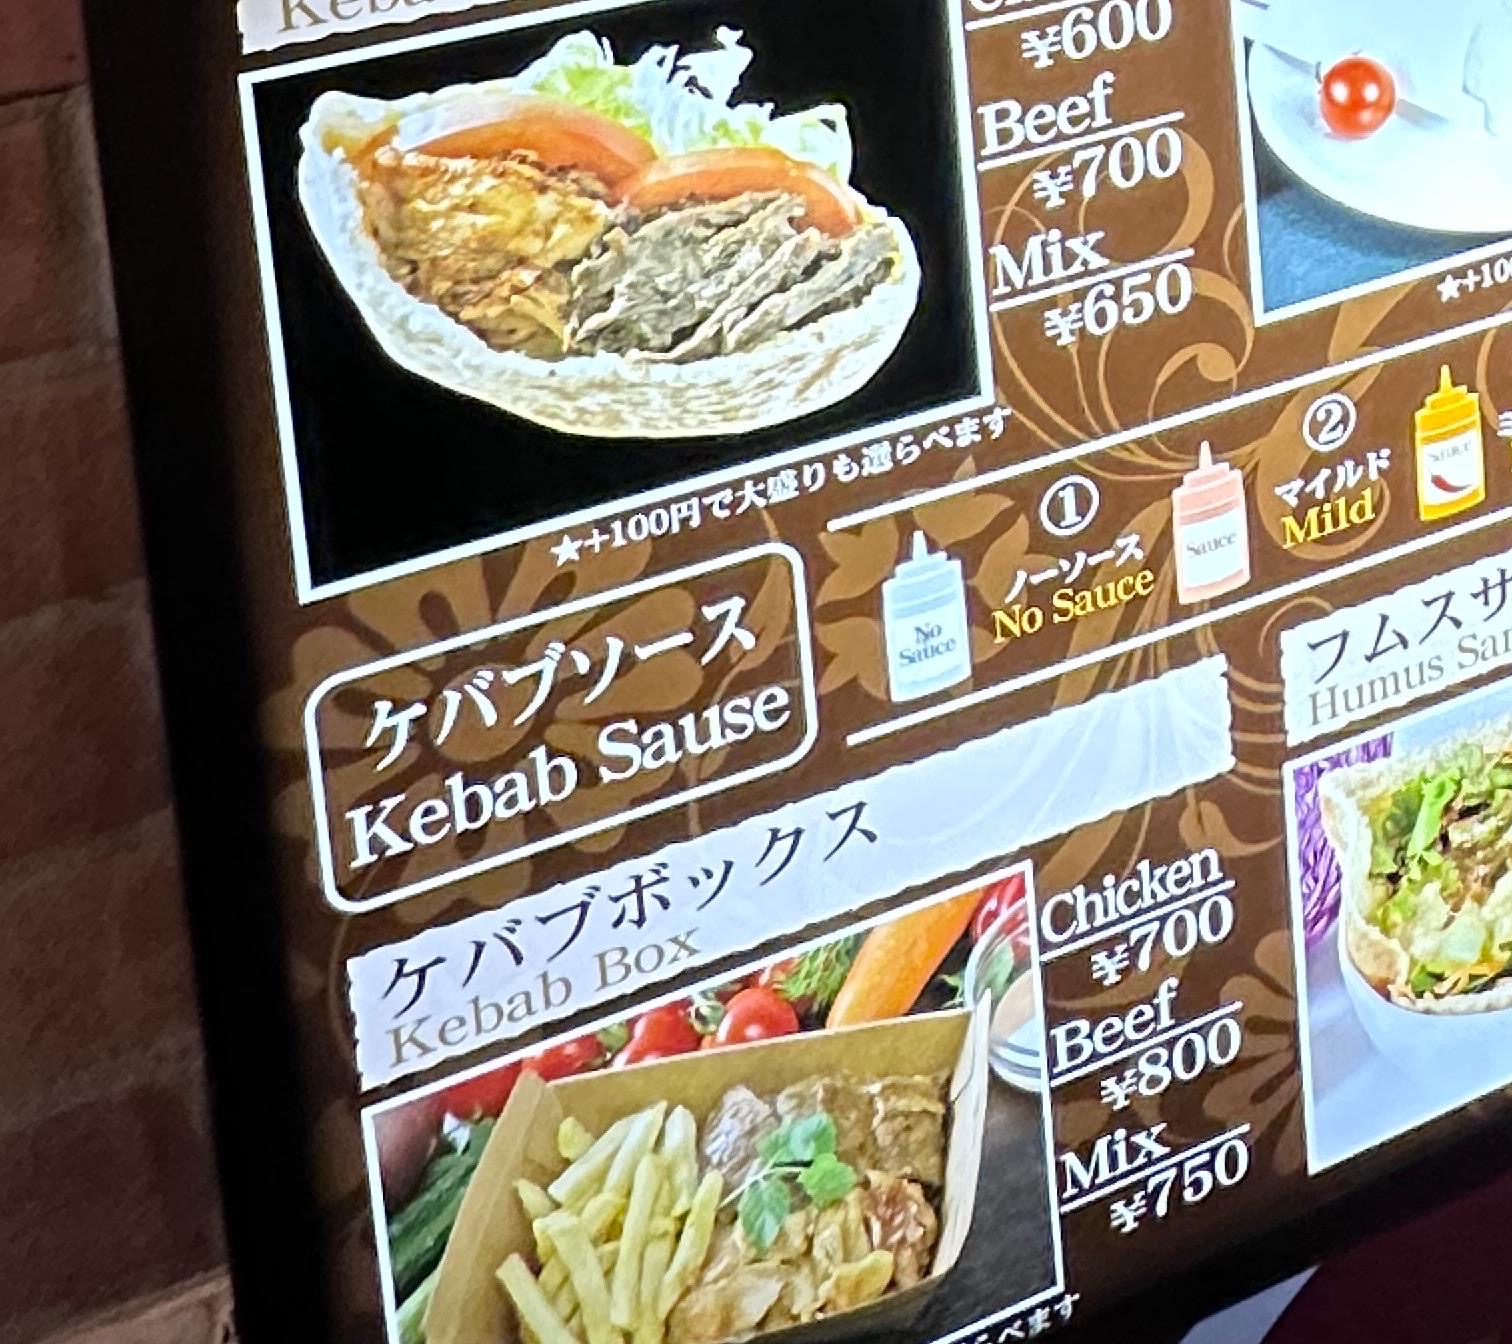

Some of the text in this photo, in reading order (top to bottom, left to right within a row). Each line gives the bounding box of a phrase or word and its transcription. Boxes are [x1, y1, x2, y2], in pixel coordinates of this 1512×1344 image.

[978, 77, 1115, 158] Beef
[1033, 127, 1183, 209] ¥700
[989, 223, 1109, 299] Mix
[1045, 264, 1193, 347] ¥650
[1274, 447, 1392, 509] マイルド
[1185, 531, 1239, 560] Sauce
[1281, 489, 1377, 551] Mild
[991, 565, 1156, 645] No Sauce
[1003, 532, 1146, 607] ノーソース
[898, 633, 958, 667] Sauce
[913, 623, 944, 645] No
[363, 588, 758, 773] ケバブソース
[1308, 656, 1445, 728] Humus
[344, 683, 793, 872] Kebab Sause
[382, 799, 880, 1018] ケバブボックス
[1040, 844, 1222, 946] Chicken
[1091, 893, 1234, 988] ¥700
[387, 923, 703, 1069] Kebab Box
[1049, 979, 1179, 1074] Beef
[1100, 1018, 1242, 1112] ¥800
[1061, 1112, 1171, 1196] Mix
[1111, 1138, 1250, 1235] ¥750
